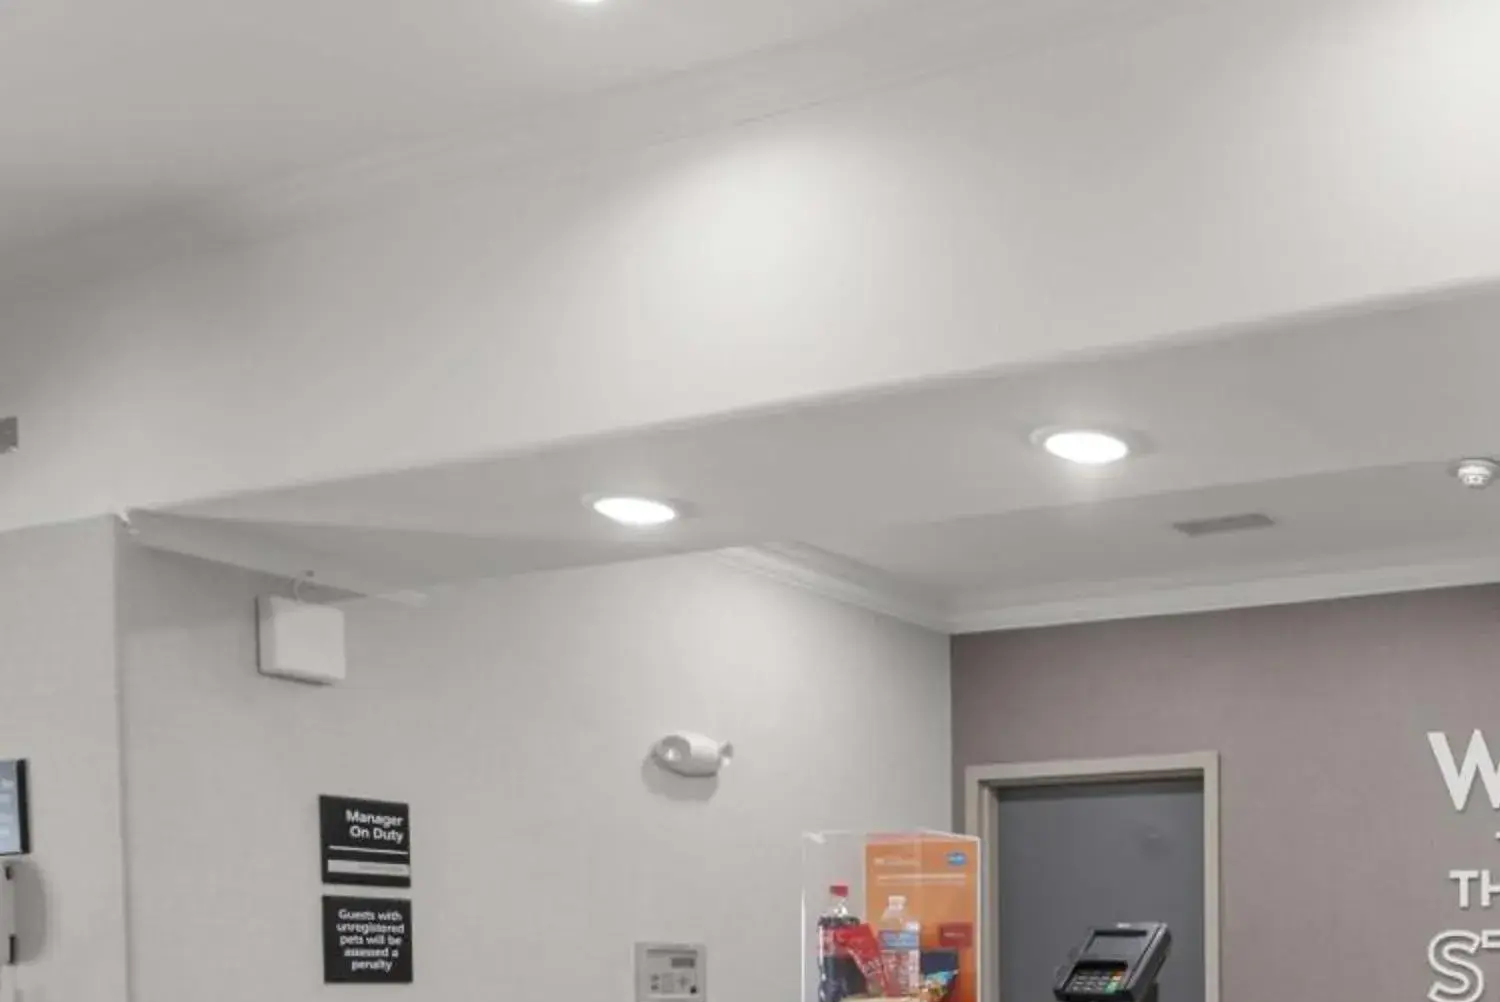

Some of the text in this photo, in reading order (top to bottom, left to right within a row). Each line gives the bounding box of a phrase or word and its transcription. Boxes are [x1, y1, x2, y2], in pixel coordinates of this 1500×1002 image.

[345, 809, 404, 828] Manager
[350, 825, 404, 844] On Duty
[338, 908, 403, 921] Guests with
[335, 922, 405, 935] unregistered
[339, 934, 364, 947] pets
[387, 934, 402, 946] be
[351, 959, 393, 973] penalty
